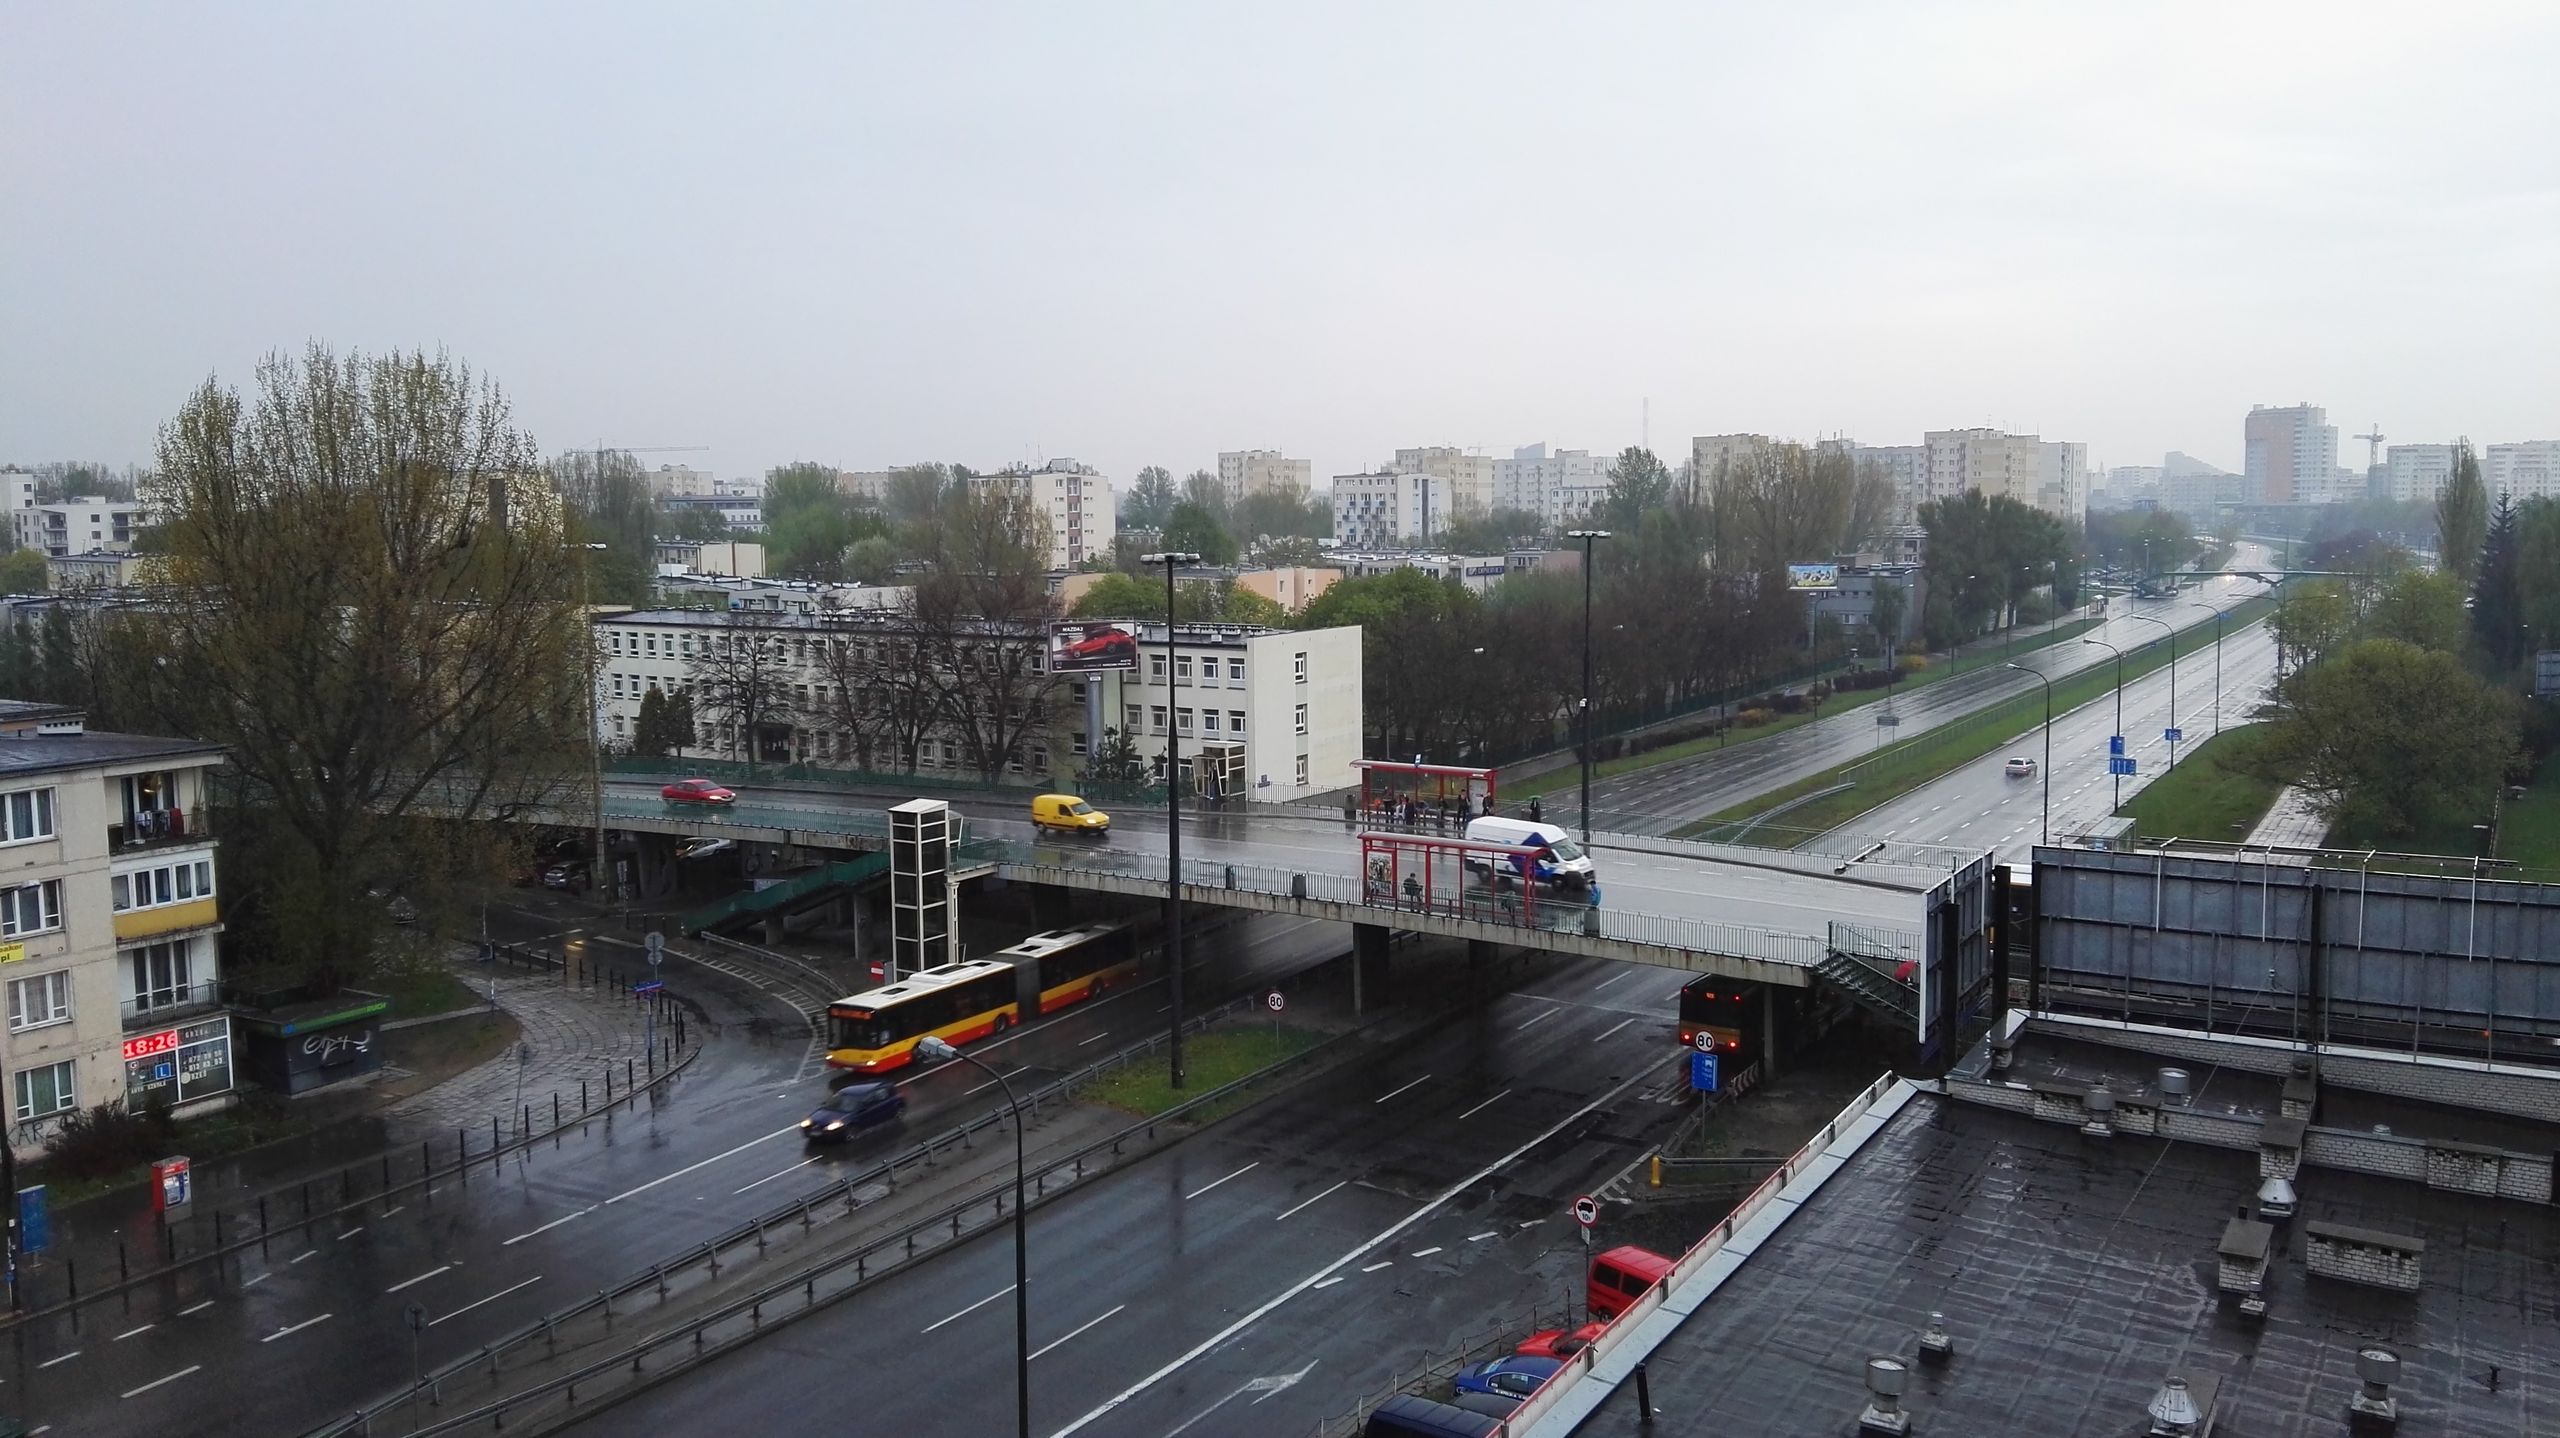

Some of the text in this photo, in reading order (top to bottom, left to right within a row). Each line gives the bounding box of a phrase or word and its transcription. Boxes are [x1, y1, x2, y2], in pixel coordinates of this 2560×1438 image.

[1270, 996, 1282, 1007] 80
[124, 1033, 177, 1057] 18:26
[1697, 1034, 1712, 1048] 80
[160, 1067, 167, 1077] L
